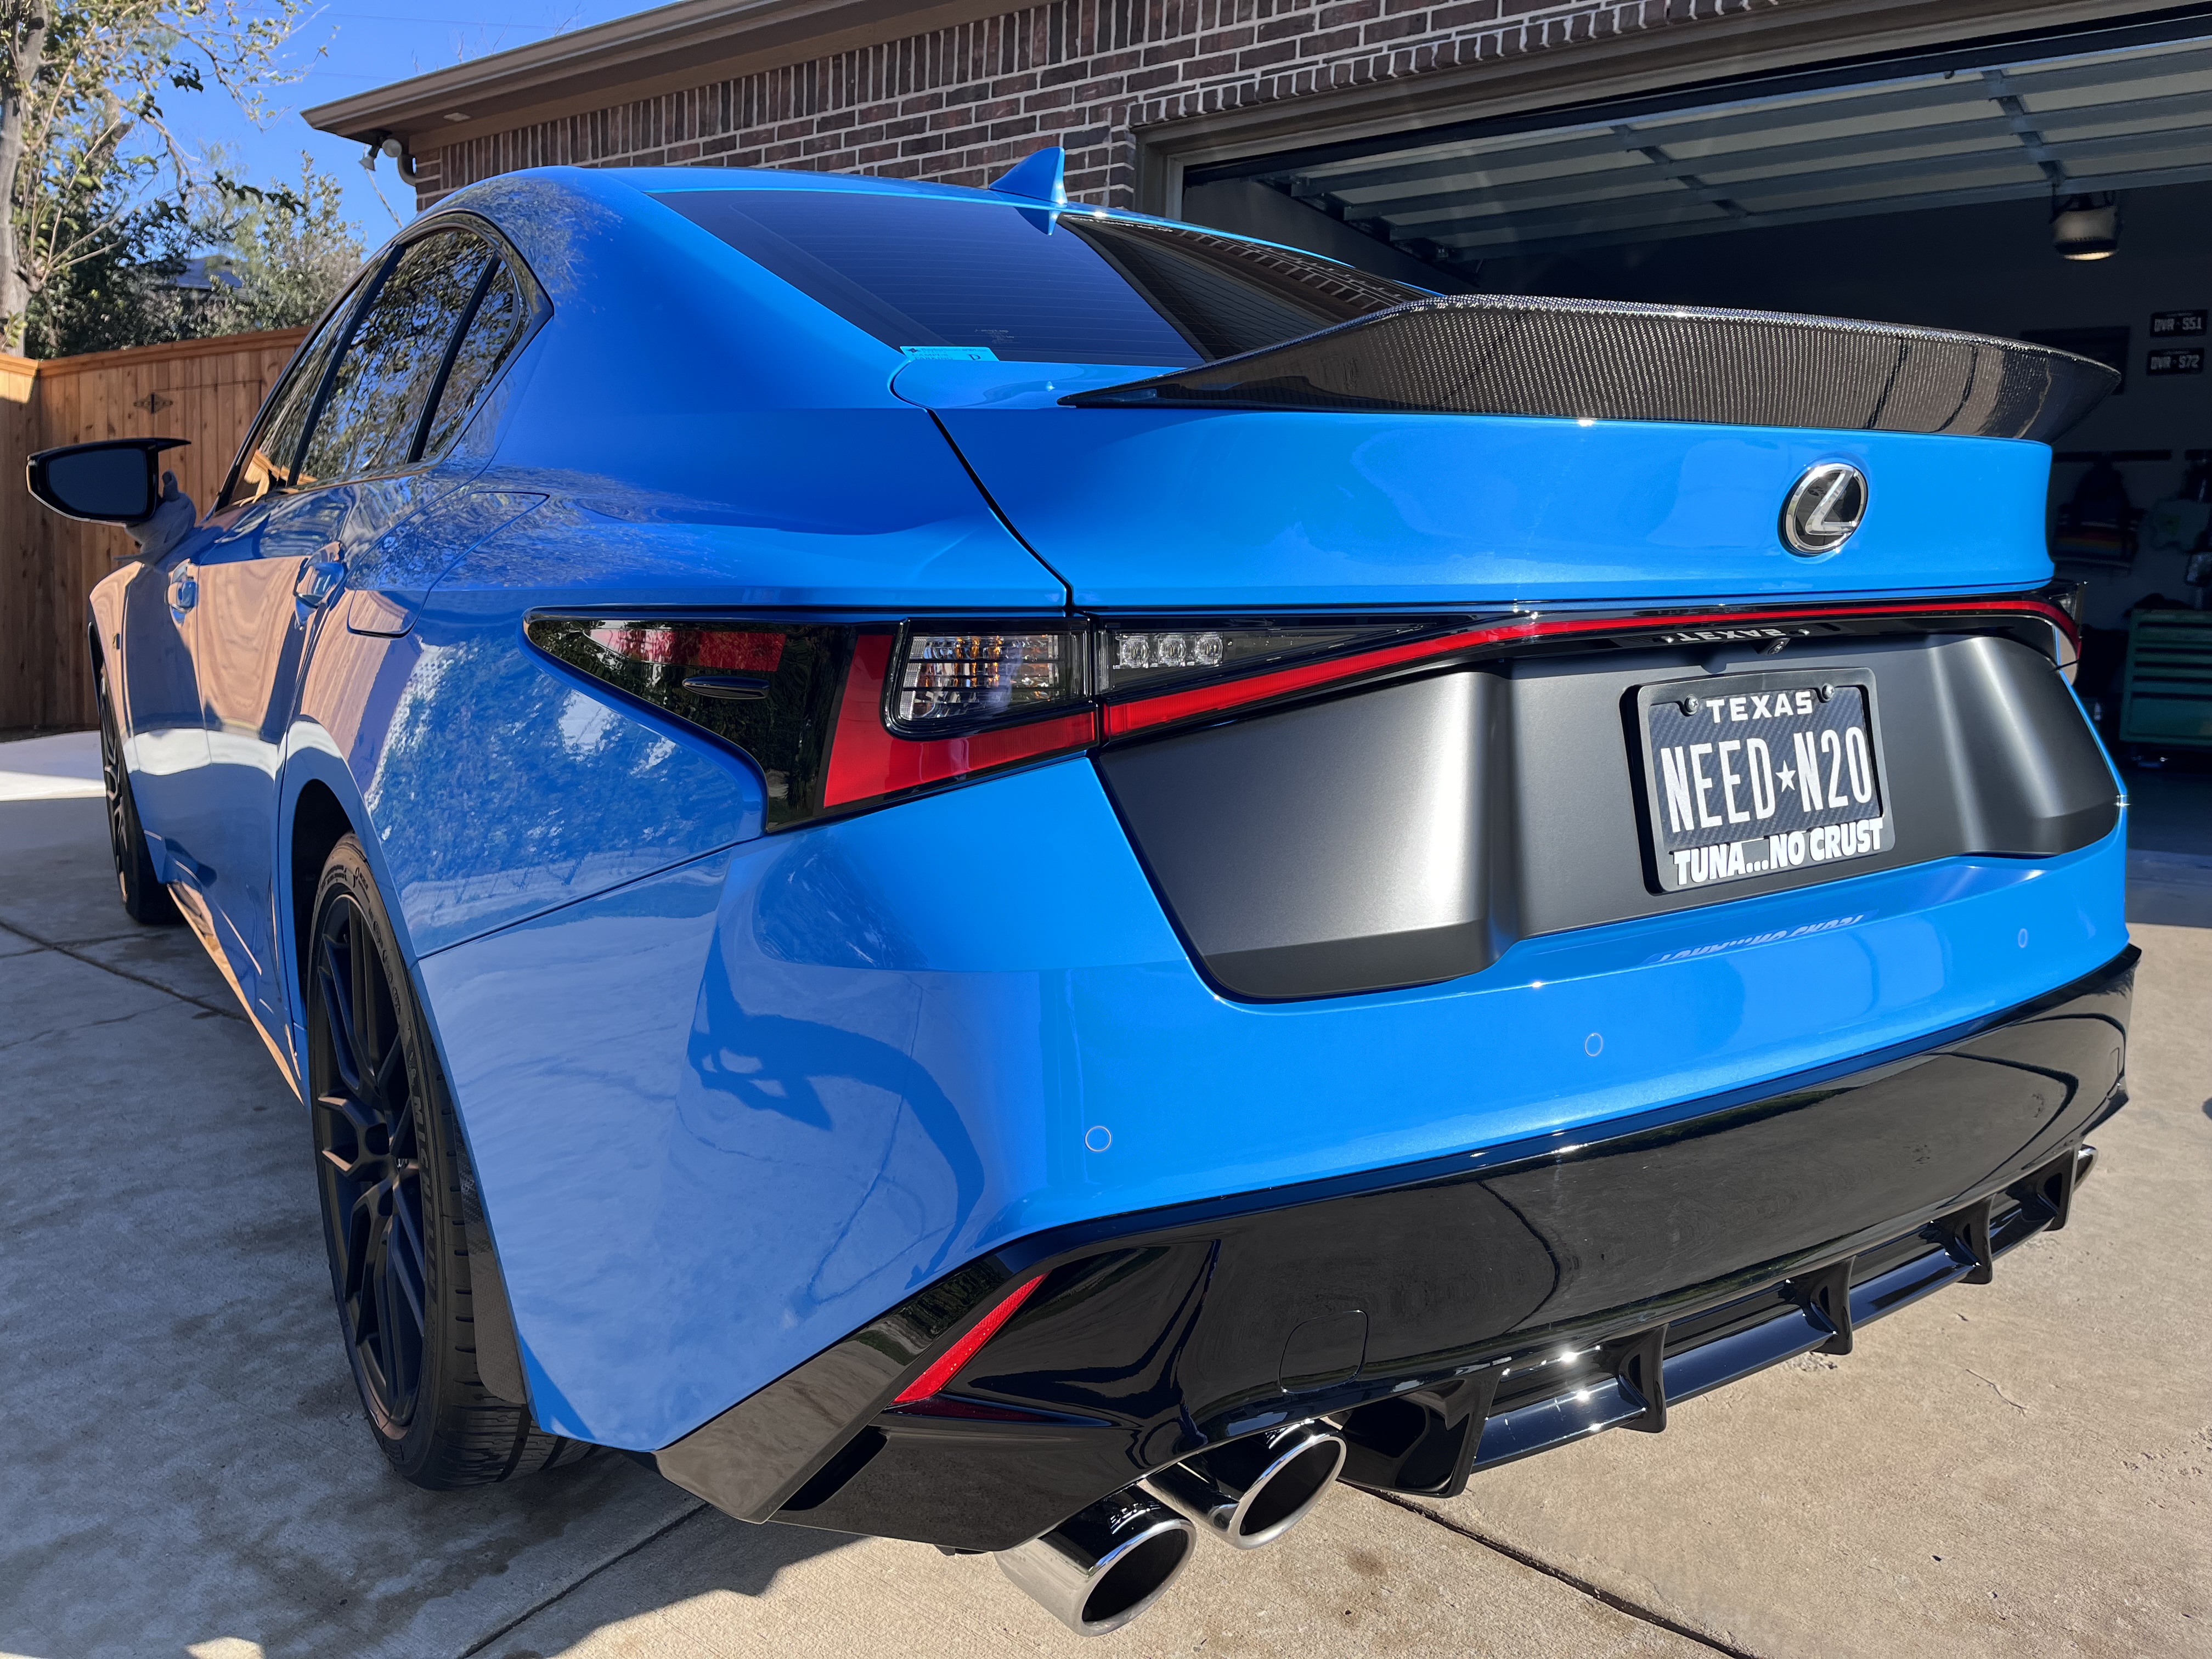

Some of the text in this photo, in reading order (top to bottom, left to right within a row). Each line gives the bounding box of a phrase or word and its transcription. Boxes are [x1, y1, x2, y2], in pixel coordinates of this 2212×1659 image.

[1706, 691, 1813, 723] TEXAS
[1660, 737, 1776, 833] NEED
[1809, 818, 1884, 862] CRUST
